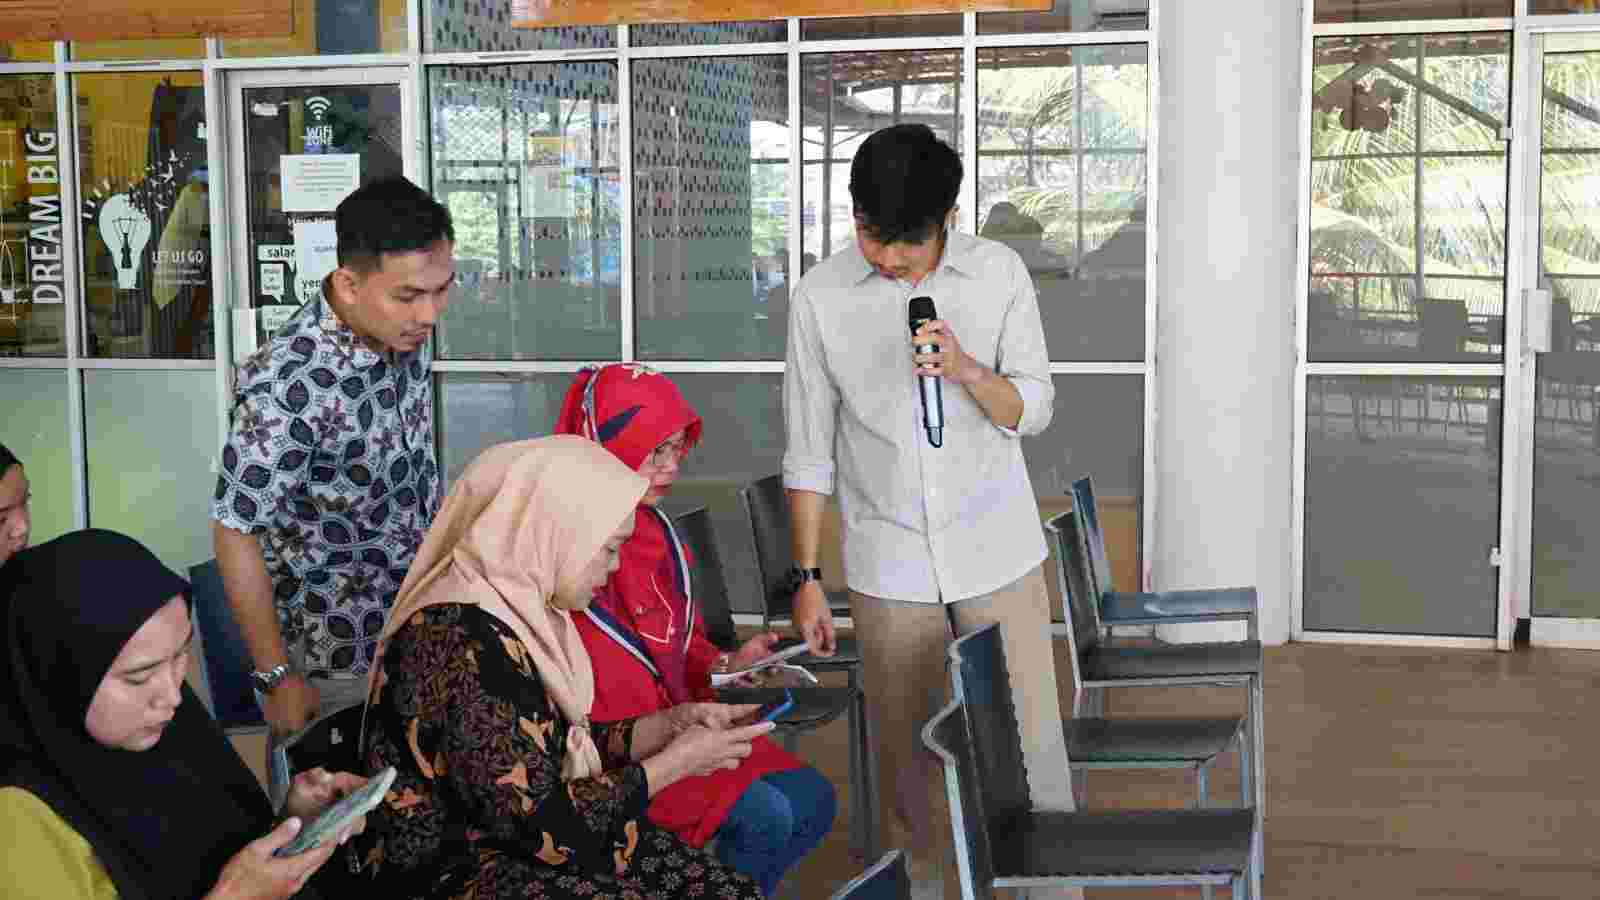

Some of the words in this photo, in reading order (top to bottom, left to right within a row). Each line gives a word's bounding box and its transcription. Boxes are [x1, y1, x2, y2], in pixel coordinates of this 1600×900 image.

[25, 131, 58, 184] BIG
[29, 193, 65, 304] DREAM
[187, 250, 204, 264] GO
